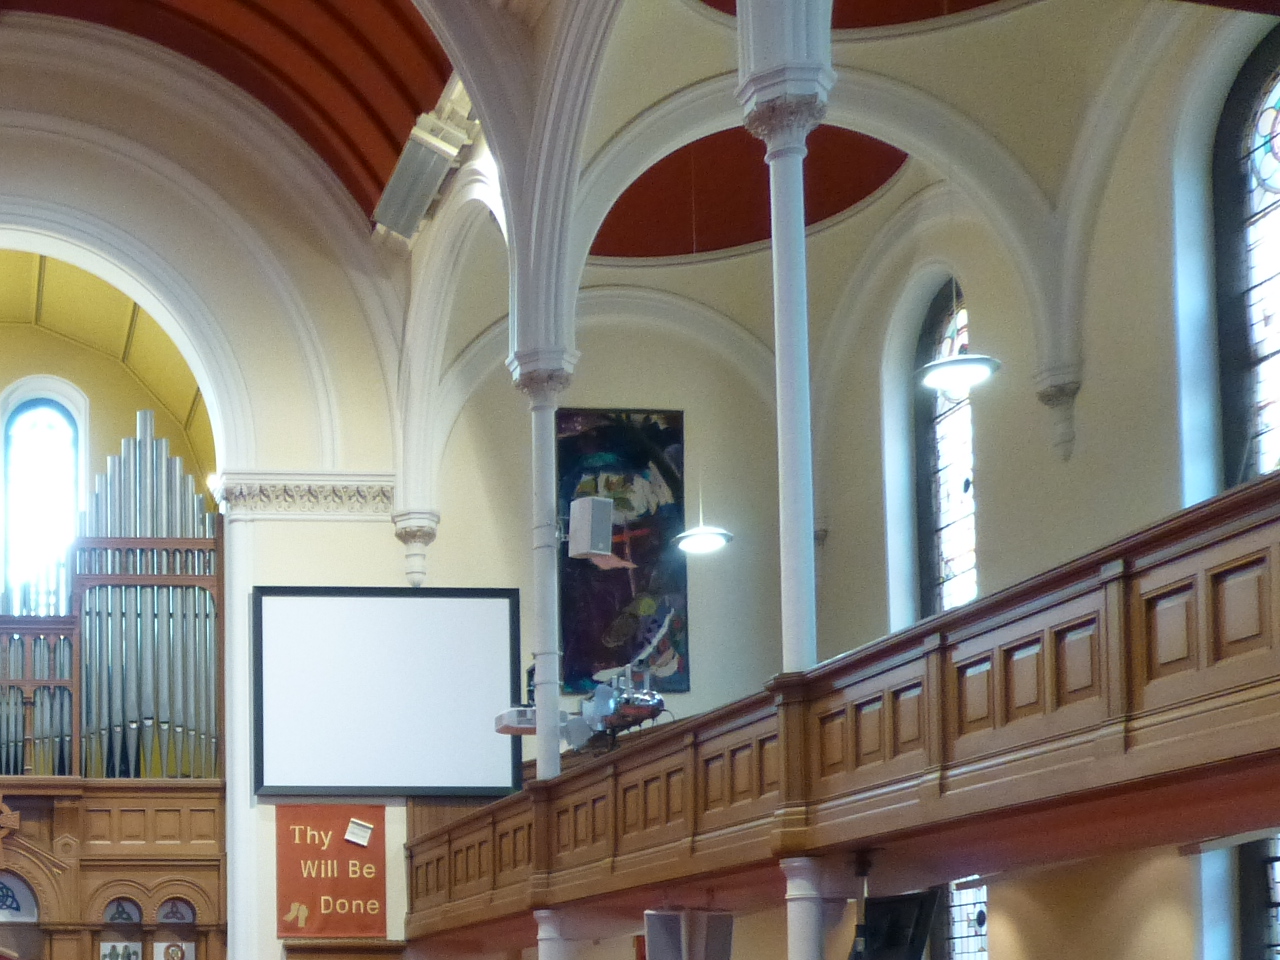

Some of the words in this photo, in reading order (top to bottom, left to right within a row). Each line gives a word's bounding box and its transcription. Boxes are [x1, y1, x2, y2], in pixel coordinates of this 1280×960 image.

[289, 826, 333, 850] Thy
[300, 860, 337, 878] Will
[348, 860, 376, 878] Be
[320, 896, 379, 914] Done
